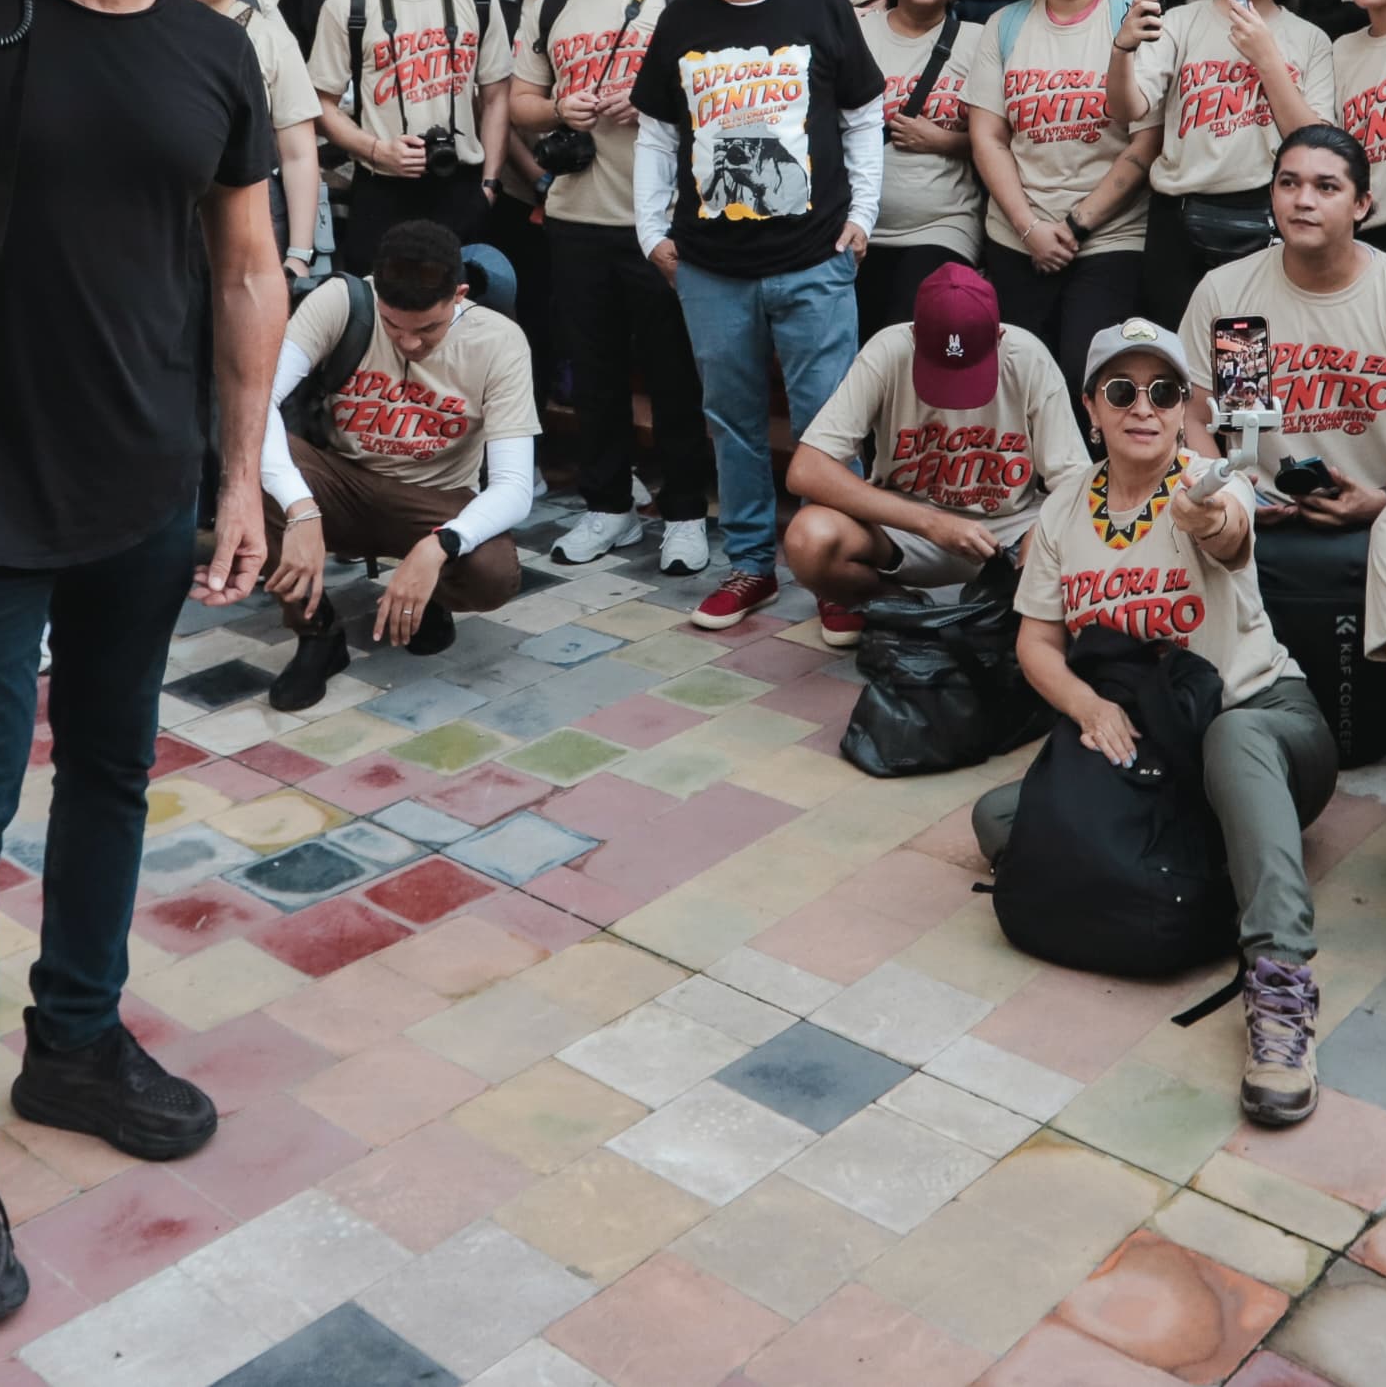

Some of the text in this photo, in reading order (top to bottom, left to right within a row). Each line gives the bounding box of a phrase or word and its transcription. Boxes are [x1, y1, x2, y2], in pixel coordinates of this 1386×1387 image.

[557, 49, 647, 99] CENTR
[692, 61, 800, 97] EXPLORA EL
[1004, 69, 1096, 100] EXPLORA
[697, 79, 803, 128] CENTRO
[1178, 80, 1268, 140] CENT
[1269, 342, 1359, 374] PLORA
[337, 369, 466, 415] EXPLORA EL
[331, 399, 469, 439] CENTRO
[892, 421, 1028, 461] EXPLORA EL
[885, 450, 1032, 494] CENTRO
[1340, 643, 1352, 675] K&F
